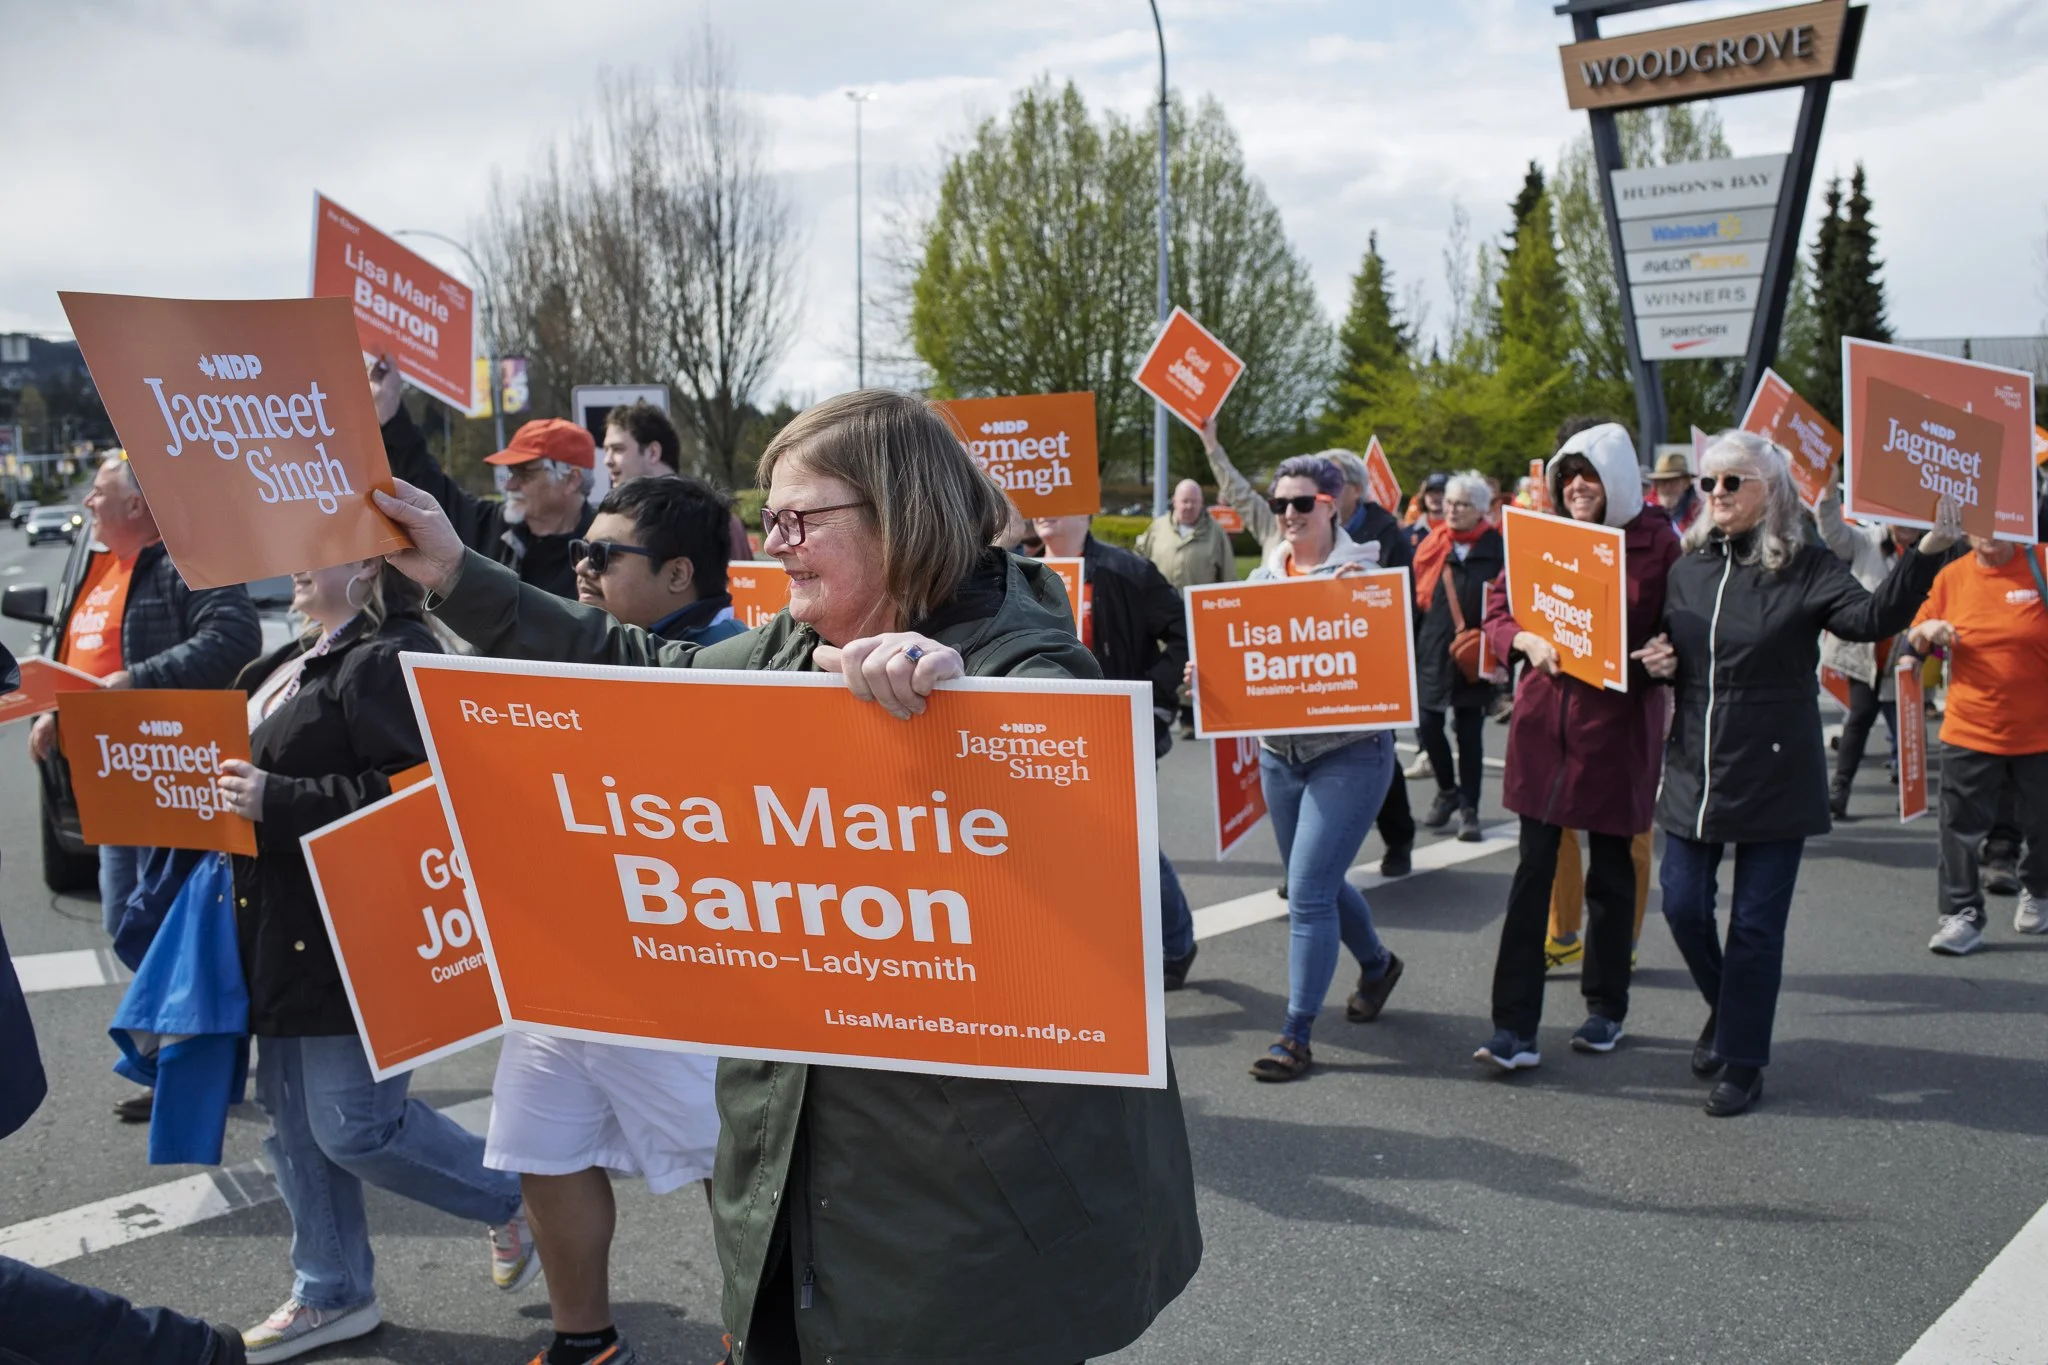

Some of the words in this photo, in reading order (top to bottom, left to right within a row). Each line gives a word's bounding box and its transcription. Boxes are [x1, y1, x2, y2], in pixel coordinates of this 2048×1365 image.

[1580, 24, 1813, 86] WOODGROVE
[1623, 180, 1724, 200] HUDSON'S
[1731, 173, 1771, 190] BAY
[1652, 222, 1718, 241] Walmart
[345, 243, 388, 288] Lisa
[393, 272, 449, 323] Marie
[1644, 287, 1746, 307] WINNERS
[355, 276, 439, 349] Barron
[212, 354, 262, 380] NDP
[143, 377, 335, 460] Jagmeet
[992, 420, 1028, 434] NDP
[1930, 421, 1956, 441] NDP
[1883, 417, 1982, 479] Jagmeet
[246, 442, 354, 515] Singh
[989, 460, 1072, 496] Singh
[1920, 463, 1978, 507] Singh
[1531, 583, 1593, 632] Jagmeet
[1228, 621, 1282, 648] Lisa
[1289, 613, 1369, 643] Marie
[1553, 620, 1592, 659] Singh
[1244, 651, 1357, 682] Barron
[150, 721, 183, 736] NDP
[460, 699, 582, 732] Re-Elect
[1011, 723, 1046, 734] NDP
[95, 735, 222, 781] Jagmeet
[955, 729, 1088, 762] Jagmeet
[1009, 756, 1090, 786] Singh
[154, 774, 230, 821] Singh
[551, 772, 728, 843] Lisa
[753, 785, 1009, 856] Marie
[613, 853, 972, 945] Barron
[824, 1009, 1106, 1045] LisaMarieBarron.ndp.ca
